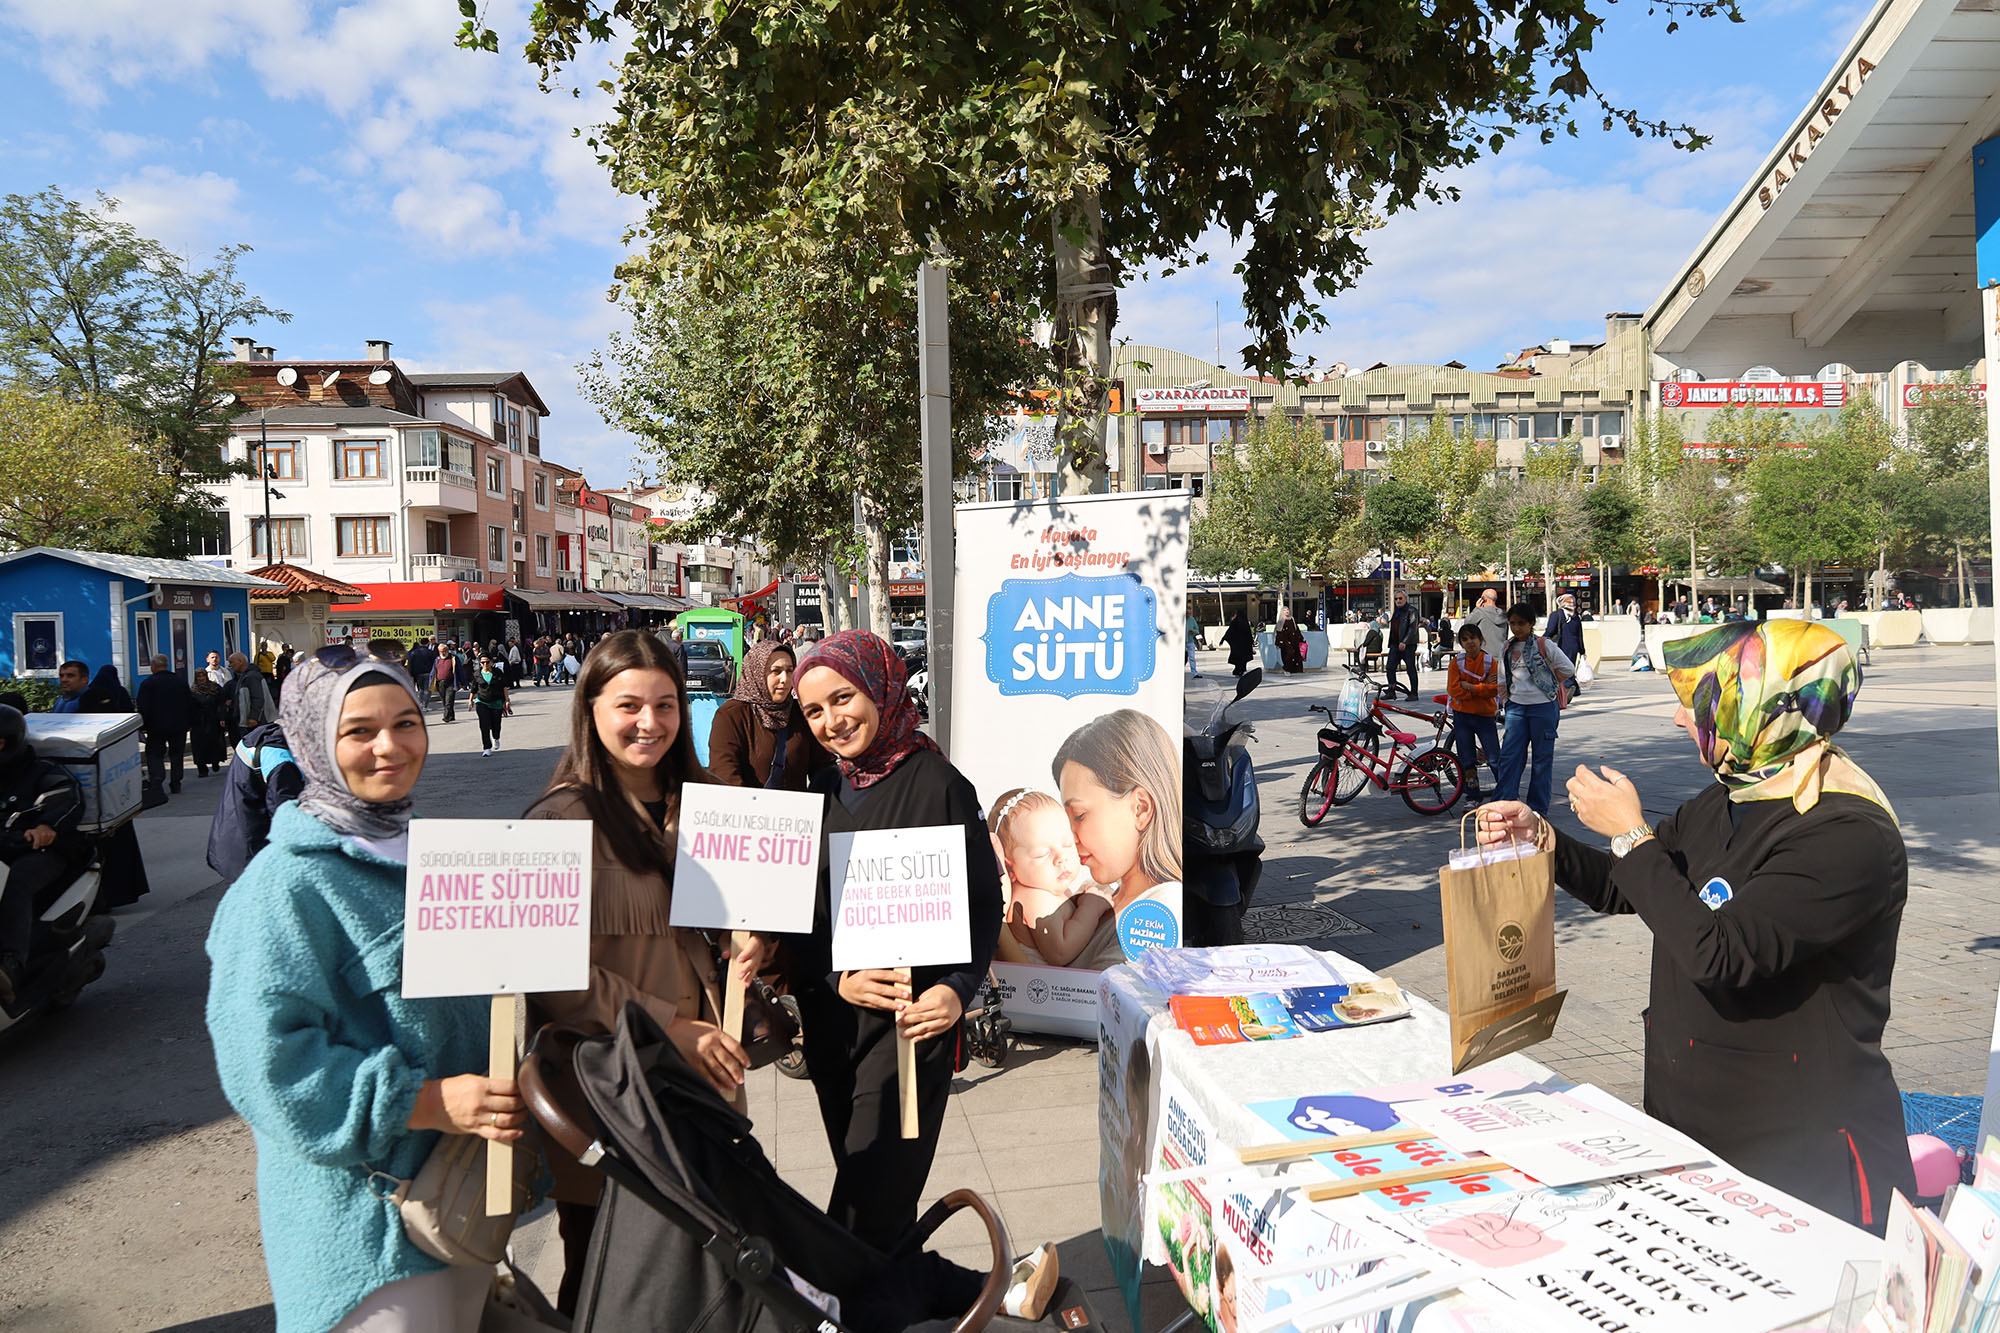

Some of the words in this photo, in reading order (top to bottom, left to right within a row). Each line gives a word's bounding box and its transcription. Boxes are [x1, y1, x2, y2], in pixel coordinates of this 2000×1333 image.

[1759, 56, 1876, 211] SAKARYA
[1155, 389, 1249, 400] KARAKADILAR
[1686, 387, 1728, 403] JANEM
[1730, 384, 1793, 403] GÜVENLİK
[1795, 387, 1820, 405] A.Ş.
[1041, 526, 1097, 546] Hayata
[1011, 554, 1029, 569] En
[1032, 549, 1053, 572] İyi
[1054, 550, 1130, 570] Başlangıç
[173, 595, 195, 605] ZABITA
[796, 598, 820, 606] EKME
[1013, 594, 1126, 632] ANNE
[1011, 630, 1125, 681] SÜTÜ
[693, 810, 741, 829] SAĞLIKLI
[743, 815, 793, 832] NESİLLER
[794, 818, 814, 835] İÇİN
[512, 852, 560, 866] GELECEK
[561, 850, 581, 868] İÇİN
[691, 832, 752, 861] ANNE
[757, 833, 812, 866] SÜTÜ
[844, 857, 894, 883] ANNE
[901, 849, 950, 881] SÜTÜ
[420, 874, 485, 901] ANNE
[491, 867, 580, 900] SÜTÜNÜ
[845, 887, 874, 901] ANNE
[876, 885, 911, 899] BEBEK
[417, 901, 580, 931] DESTEKLİYORUZ
[845, 898, 953, 929] GÜÇLENDİRİR
[1145, 920, 1165, 930] EKİM
[1129, 928, 1167, 941] EMZİRME
[1497, 964, 1527, 980] SAKARYA
[1168, 1095, 1187, 1129] ANNE
[1187, 1118, 1206, 1153] SÜTÜ
[1594, 1218, 1639, 1245] En
[1646, 1246, 1750, 1303] Güzel
[1616, 1200, 1797, 1300] Vereceğiniz
[1564, 1267, 1656, 1318] Anne
[1592, 1246, 1709, 1315] Hediye
